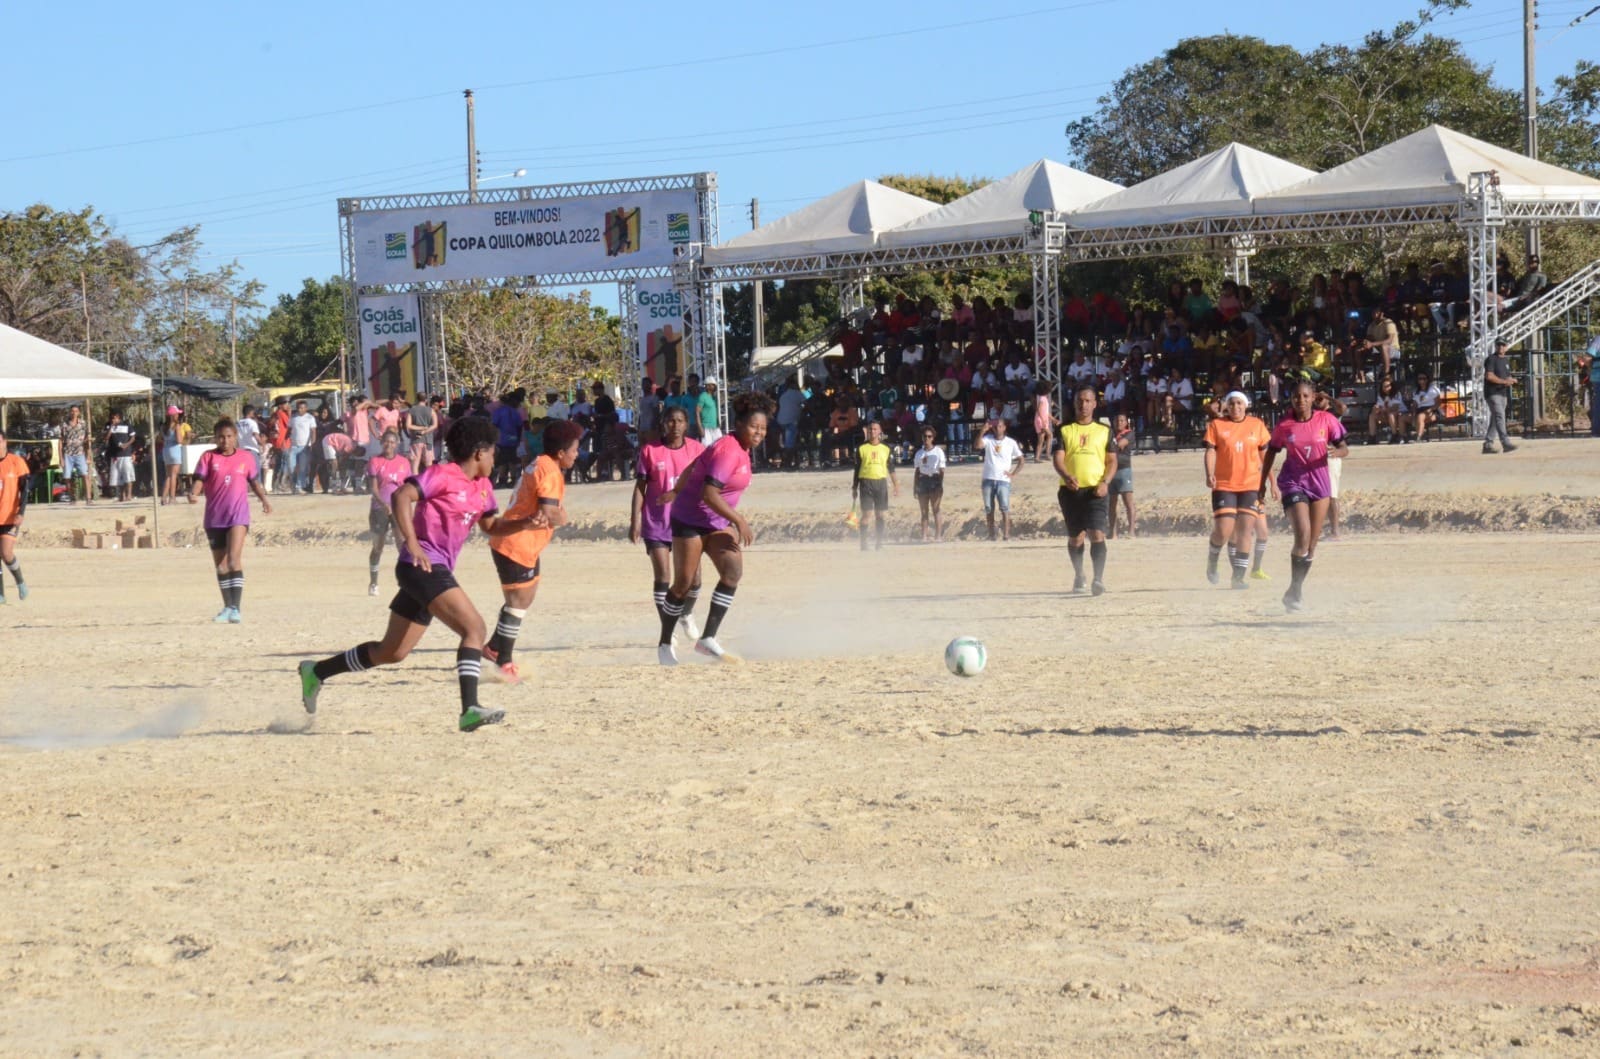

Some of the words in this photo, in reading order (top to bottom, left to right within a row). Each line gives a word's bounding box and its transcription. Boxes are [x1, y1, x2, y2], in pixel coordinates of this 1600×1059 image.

[494, 207, 562, 226] BEM-VINDOS!
[449, 236, 486, 250] COPA
[488, 230, 567, 250] QUILOMBOLA
[569, 227, 600, 244] 2022
[638, 289, 681, 306] Goiás
[362, 306, 404, 323] Goiás
[373, 317, 416, 335] social
[1304, 446, 1312, 459] 7
